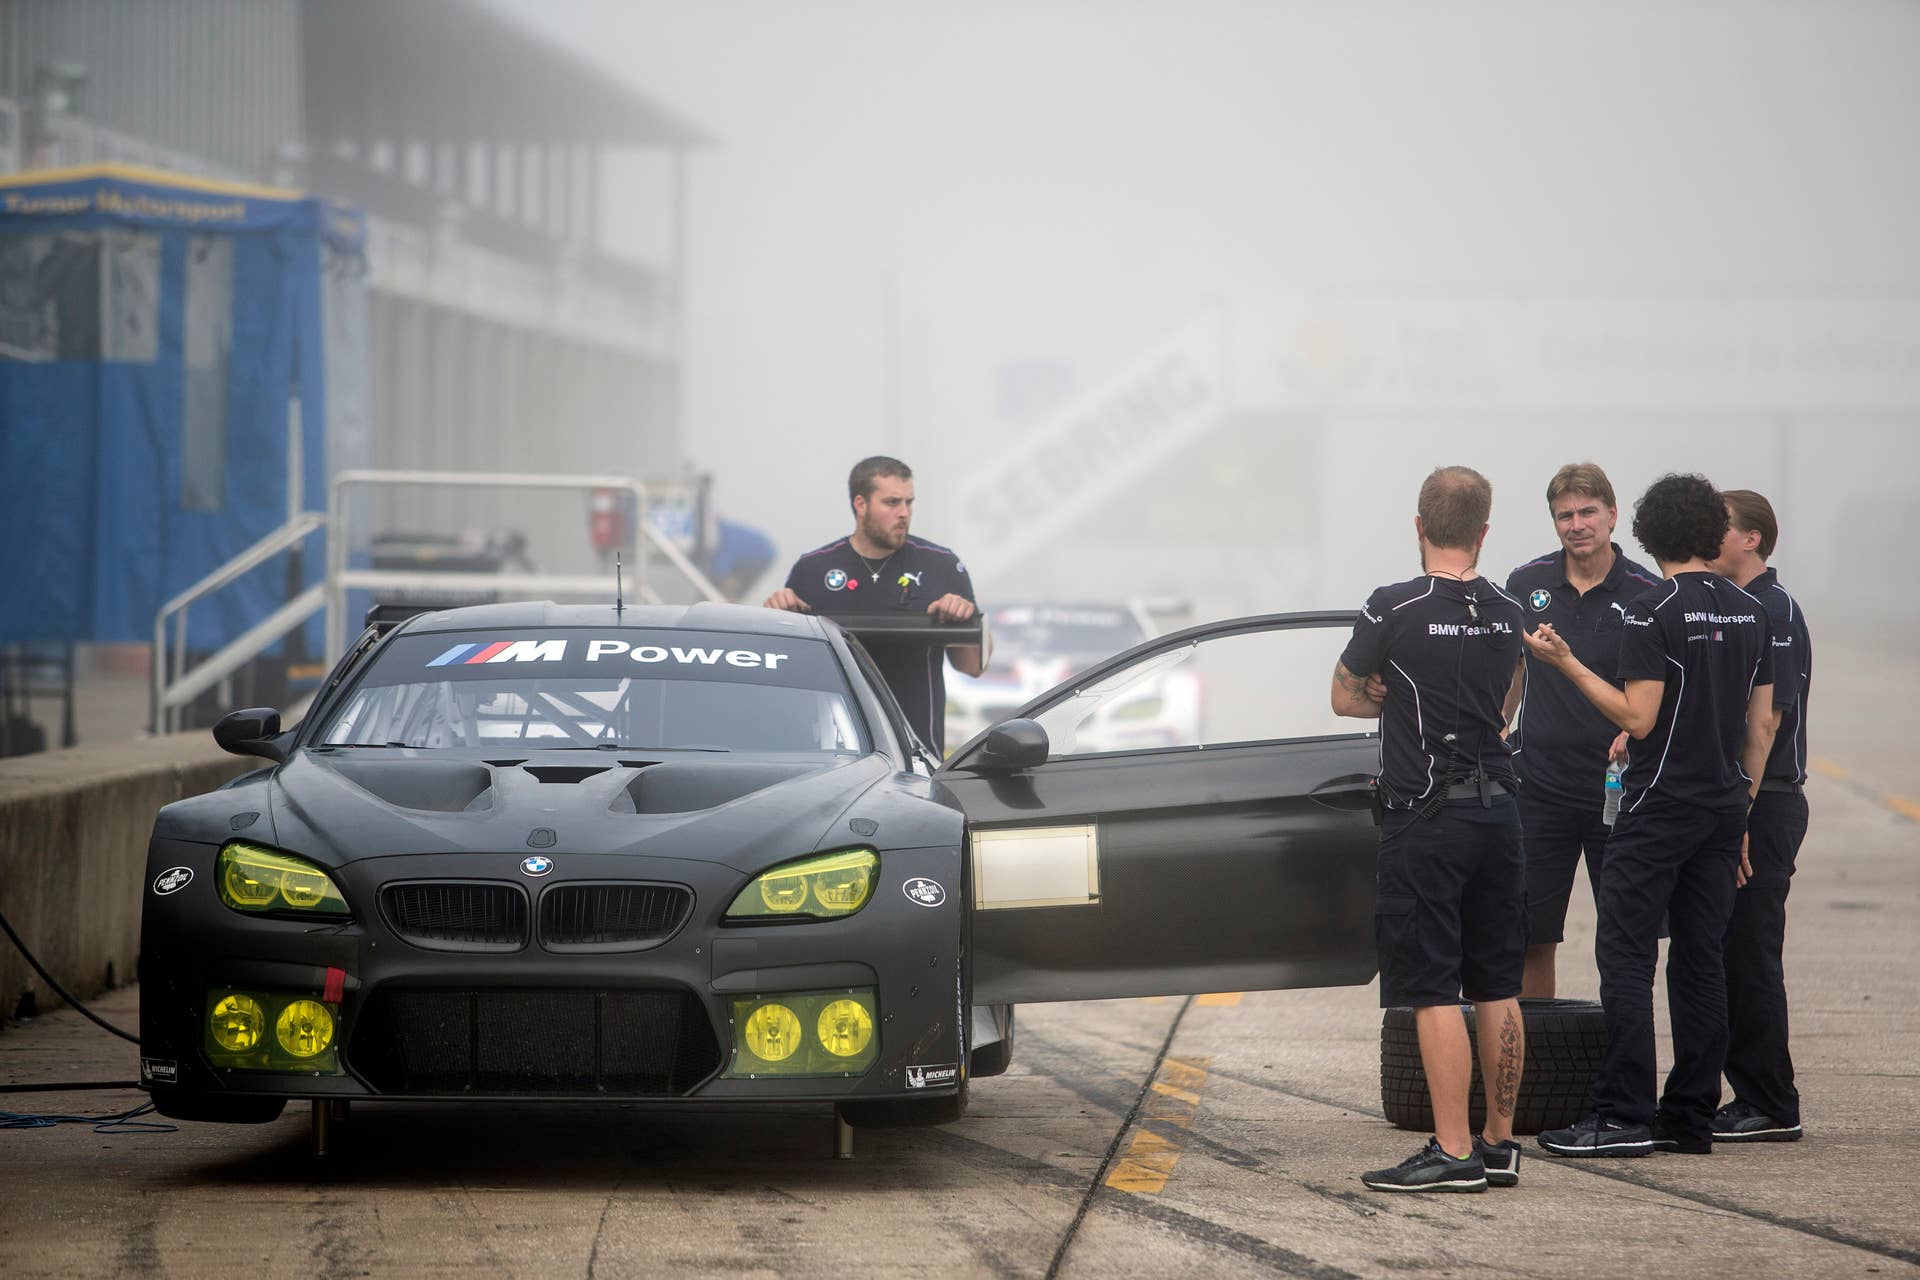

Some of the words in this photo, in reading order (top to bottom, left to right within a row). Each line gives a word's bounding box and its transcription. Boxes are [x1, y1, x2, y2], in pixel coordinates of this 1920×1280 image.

[1684, 611, 1707, 623] BMW
[1707, 612, 1756, 625] Motorsport
[1428, 623, 1460, 636] BMW
[585, 640, 789, 670] Power
[925, 1069, 956, 1079] MICHELIN
